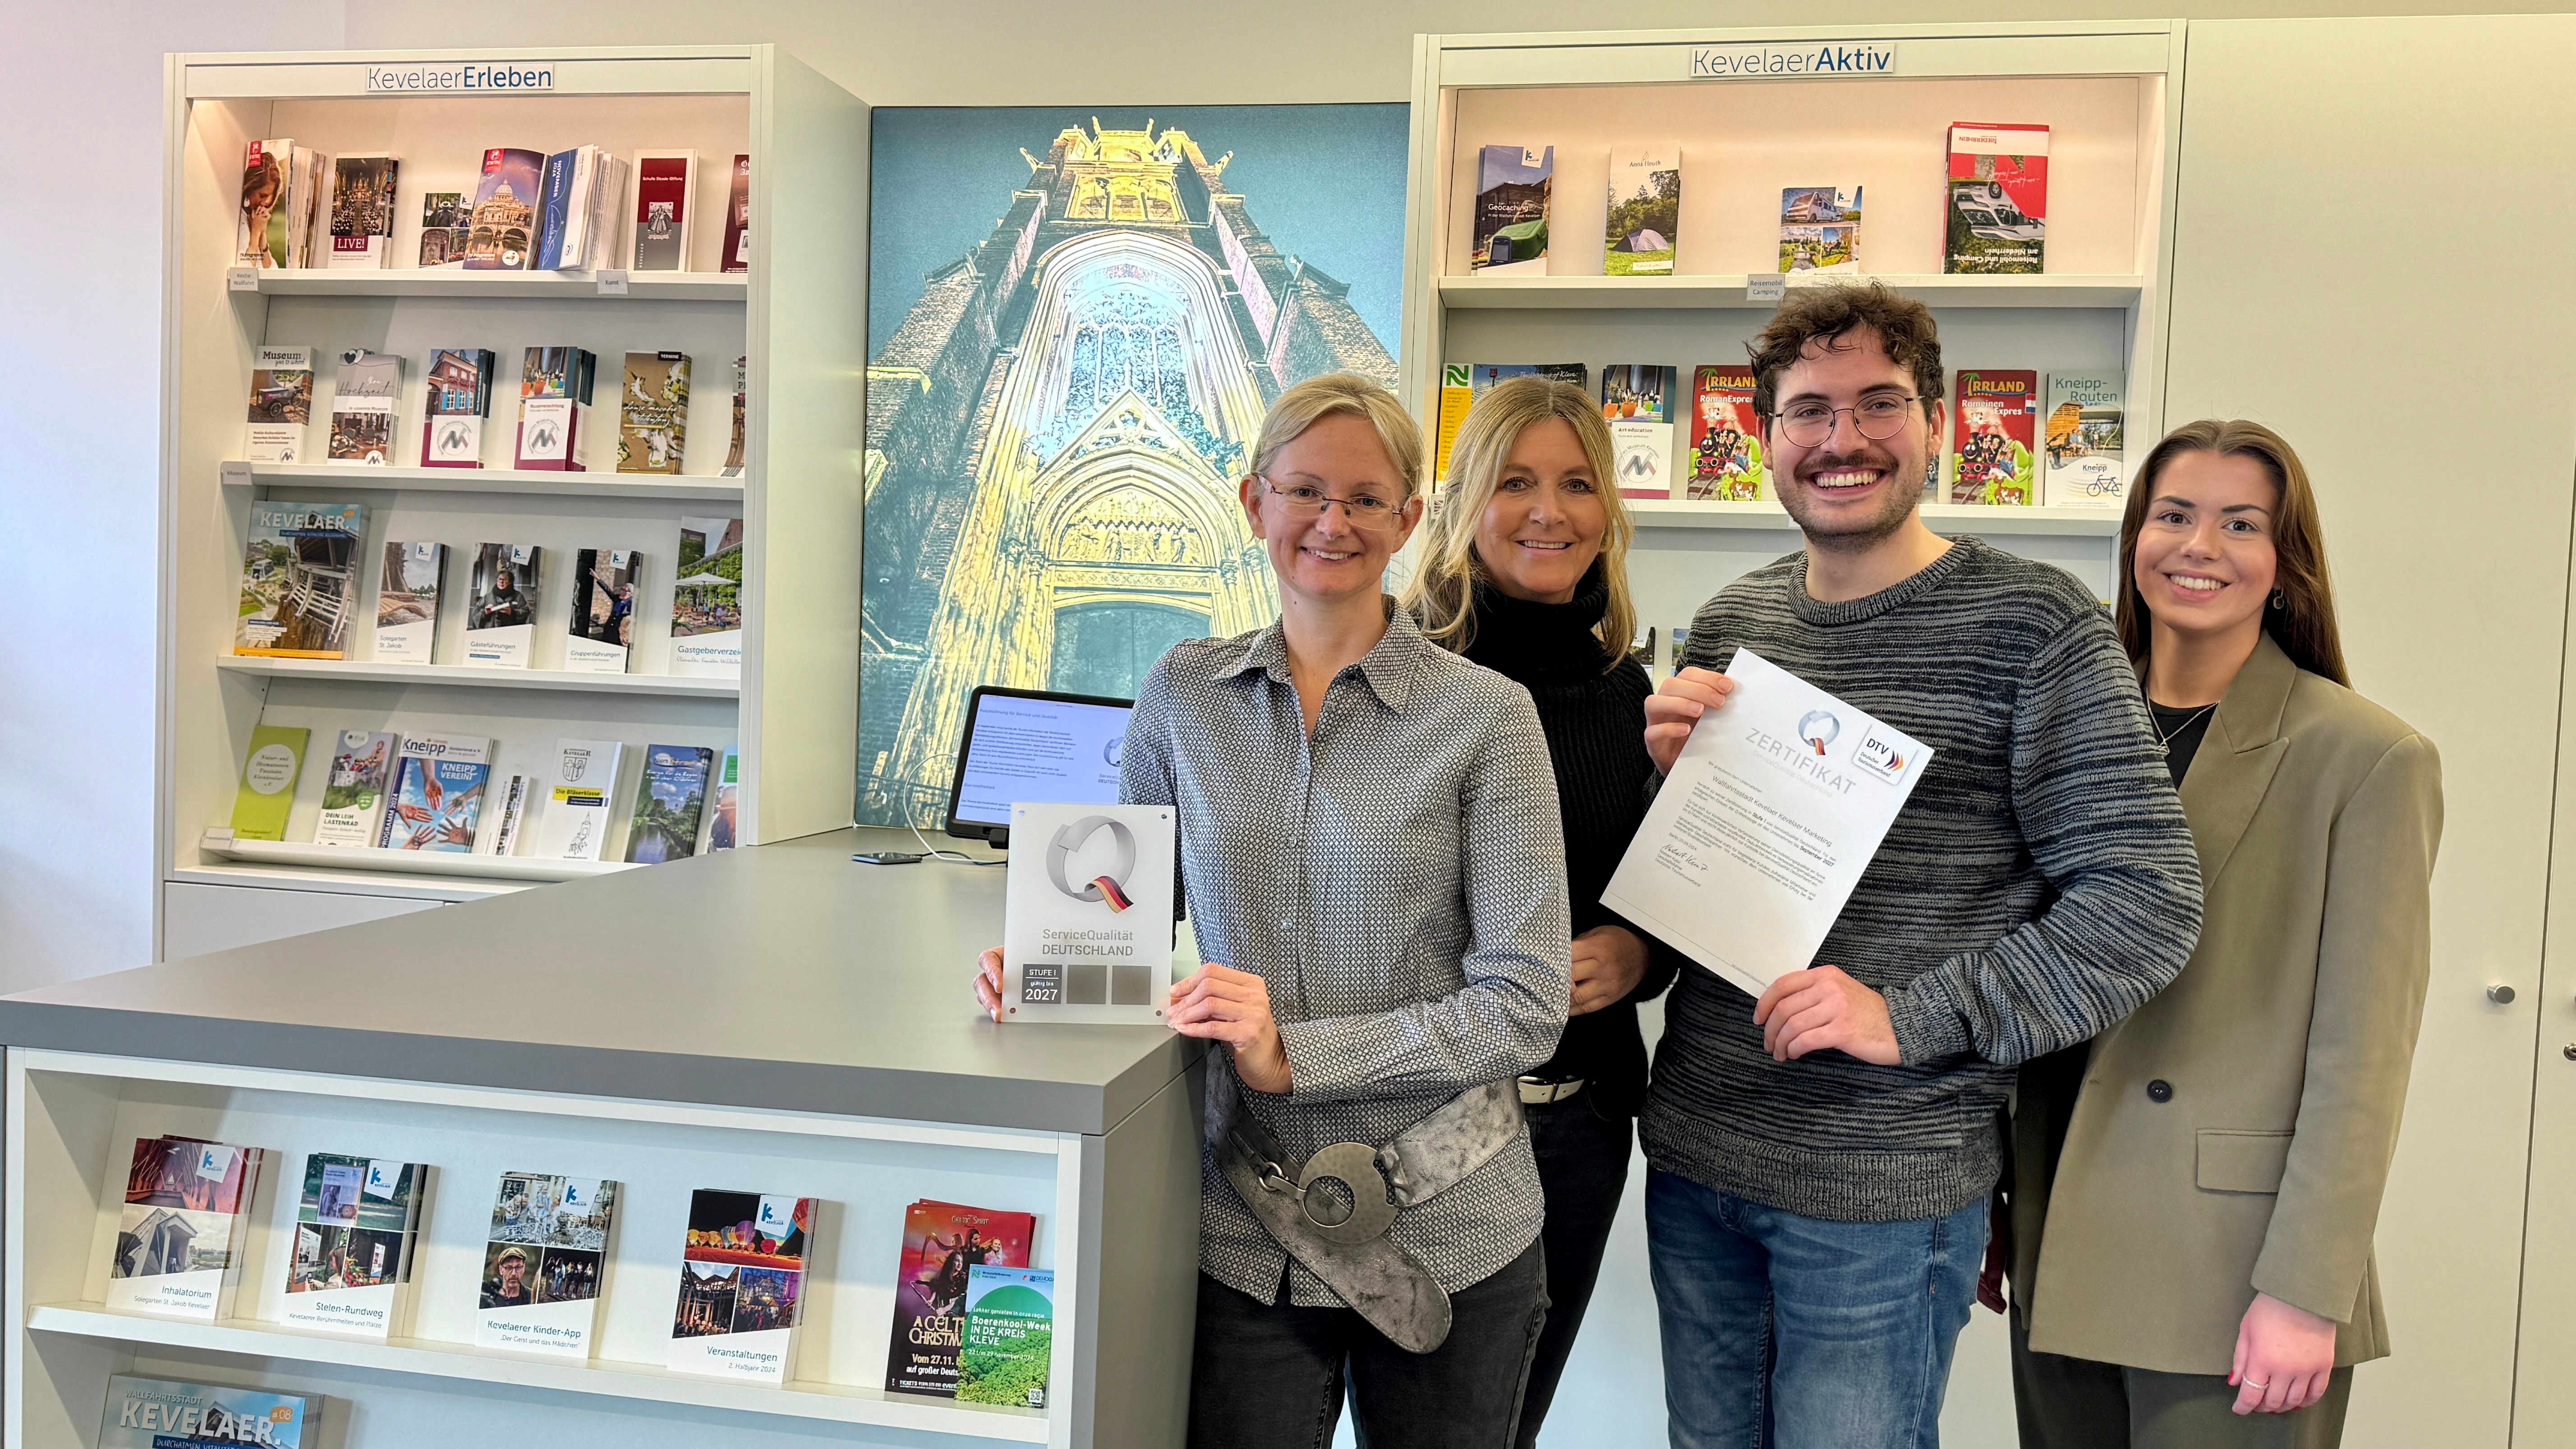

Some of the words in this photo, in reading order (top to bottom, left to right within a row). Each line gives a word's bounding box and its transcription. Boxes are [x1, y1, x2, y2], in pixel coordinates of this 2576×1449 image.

[1693, 47, 1891, 74] KevelaerAktiv
[368, 66, 552, 88] KevelaerErleben
[1488, 203, 1528, 212] Geocaching
[337, 238, 364, 248] LIVE!
[1954, 254, 1983, 262] Camping
[2056, 377, 2107, 390] Kneipp-
[2070, 391, 2117, 402] Routen
[1962, 400, 2003, 408] Romeinen
[2083, 464, 2107, 472] Kneipp
[260, 511, 350, 530] KEVELAER.
[470, 641, 515, 649] Gästeführungen
[403, 739, 446, 756] Kneipp
[1866, 738, 1890, 755] DTV
[442, 763, 477, 773] KNEIPP
[1745, 726, 1856, 797] ZERTIFIKAT
[1751, 749, 1797, 778] ServiceQualität
[1795, 773, 1833, 798] Deutschland
[1711, 775, 1754, 802] Wallfahrtsstadt
[1753, 799, 1778, 816] Kevelaer
[1778, 813, 1803, 830] Kevelaer
[1802, 827, 1832, 847] Marketing
[382, 810, 396, 849] PROGRAMM
[1752, 812, 1764, 821] Stufe
[1773, 824, 1799, 842] ServiceQualität
[1769, 829, 1793, 844] Unternehmen
[1799, 845, 1822, 860] September
[1822, 858, 1834, 867] 2027
[1043, 929, 1134, 941] ServiceQualität
[1042, 944, 1133, 956] DEUTSCHLAND
[1025, 989, 1058, 1001] 2027
[162, 1286, 212, 1299] Inhalatorium
[134, 1296, 162, 1305] Solegarten
[316, 1302, 383, 1319] Stelen-Rundweg
[289, 1313, 315, 1321] Kevelaerer
[317, 1315, 354, 1325] Berühmtheiten
[913, 1316, 923, 1327] A
[971, 1316, 1051, 1331] Boerenkool-Week
[488, 1320, 530, 1333] Kevelaerer
[534, 1325, 581, 1339] Kinder-App
[971, 1325, 981, 1334] IN
[982, 1327, 995, 1335] DE
[998, 1328, 1026, 1339] KREIS
[970, 1334, 1000, 1345] KLEVE
[707, 1346, 777, 1362] Veranstaltungen
[912, 1353, 929, 1363] Vom
[931, 1355, 954, 1365] 27.11.
[735, 1363, 759, 1372] Halbjahr
[906, 1366, 917, 1374] auf
[918, 1366, 939, 1375] großer
[126, 1389, 202, 1405] WALLFAHRTSSTADT
[120, 1400, 281, 1446] KEVELAER.
